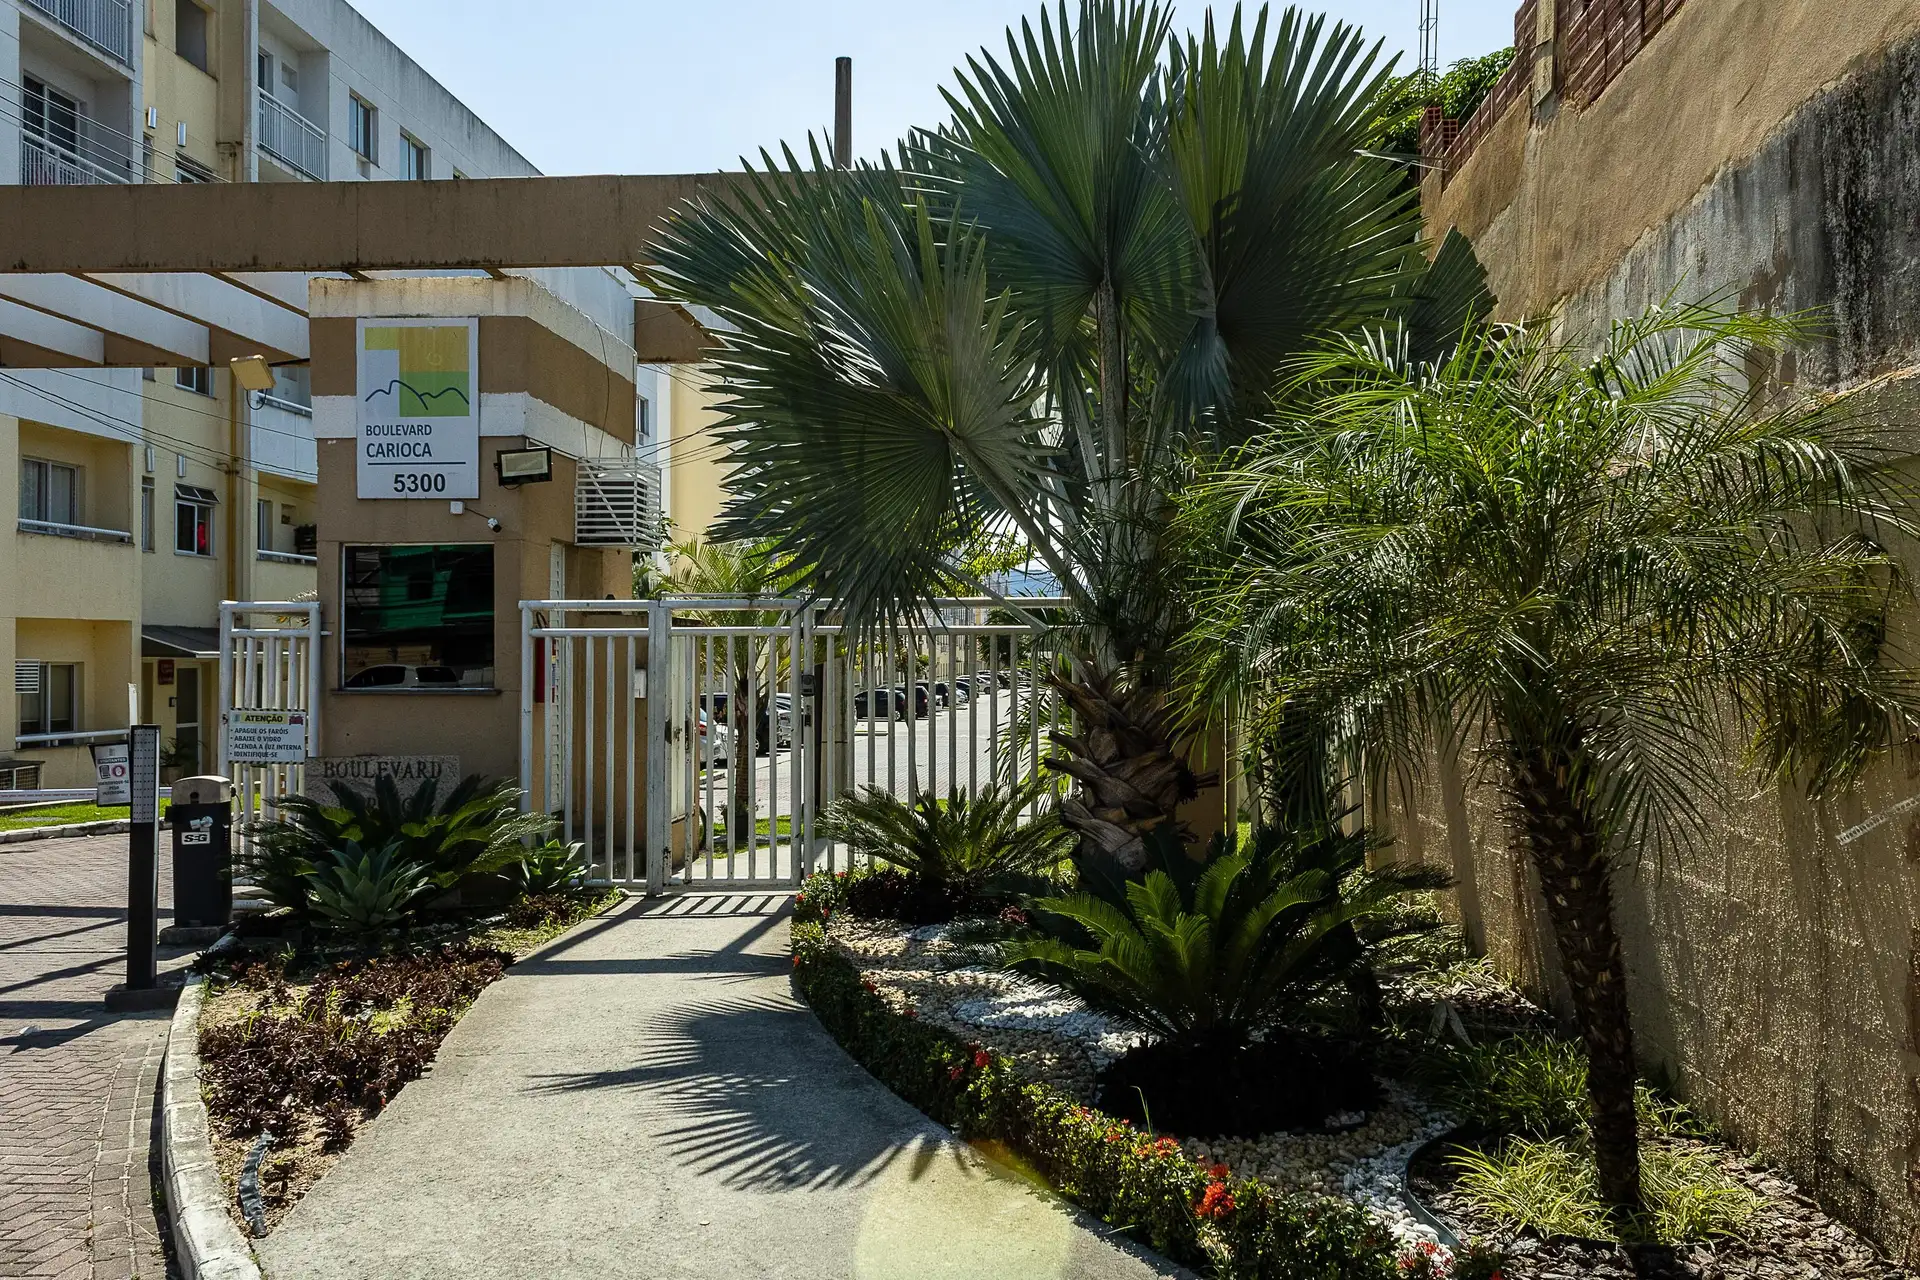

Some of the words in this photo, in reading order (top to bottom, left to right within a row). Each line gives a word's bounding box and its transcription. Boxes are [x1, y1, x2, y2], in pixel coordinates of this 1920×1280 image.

[365, 424, 432, 436] BOULEVARD
[366, 442, 432, 458] CARIOCA
[393, 473, 446, 493] 5300
[244, 714, 283, 724] ATENÇÃO
[323, 761, 442, 779] BOULEVARD
[184, 834, 208, 842] SEG
